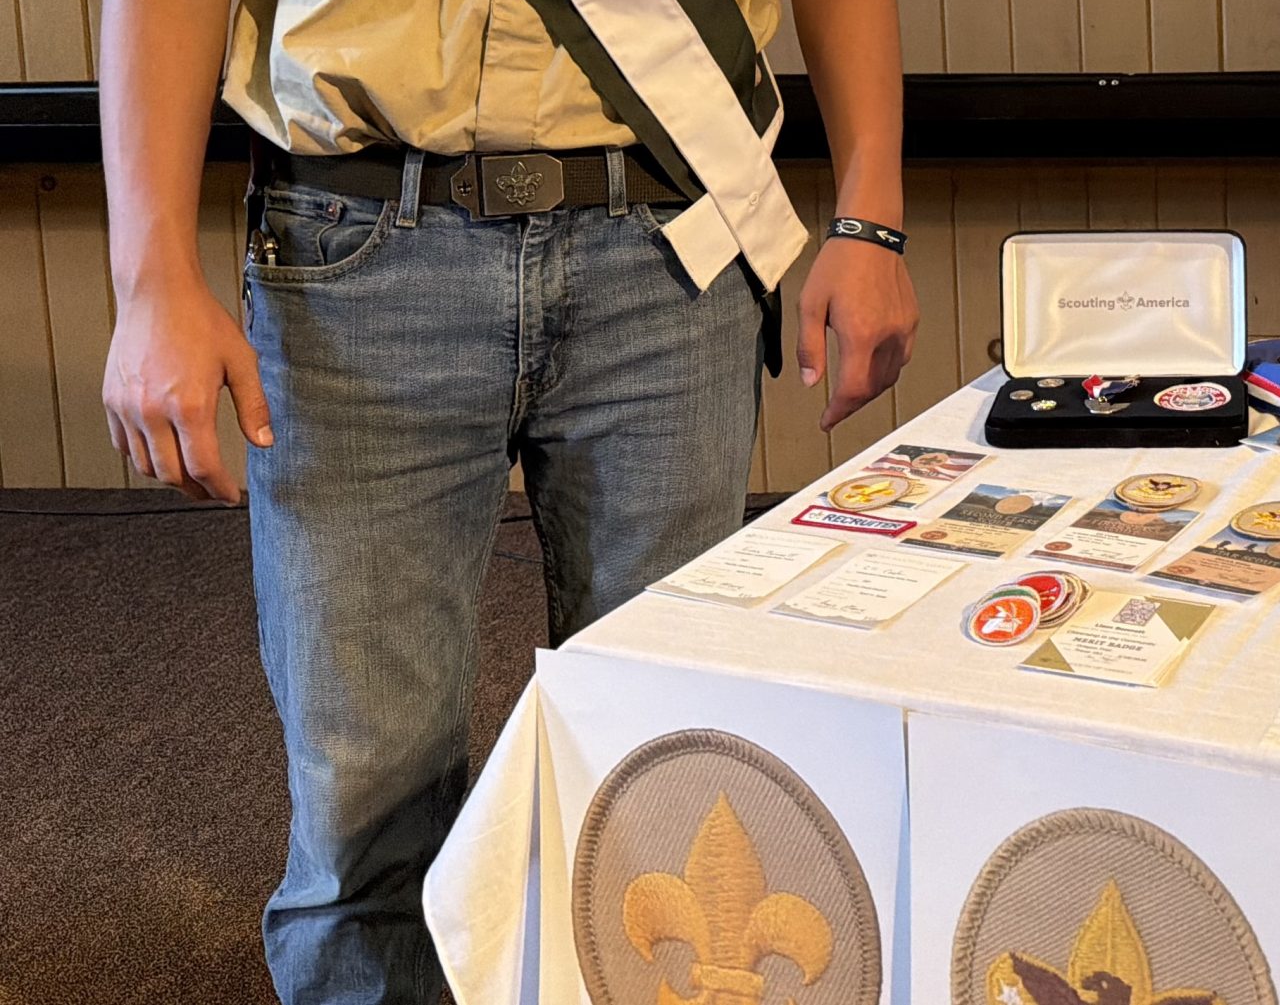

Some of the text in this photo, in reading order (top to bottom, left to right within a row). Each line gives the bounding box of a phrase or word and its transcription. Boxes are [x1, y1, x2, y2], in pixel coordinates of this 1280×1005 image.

[1058, 296, 1190, 311] Scouting America
[821, 513, 902, 529] RECRUITER
[1211, 549, 1240, 559] STAR
[1241, 555, 1280, 567] SCOUT
[1072, 636, 1144, 652] MERIT BADGE
